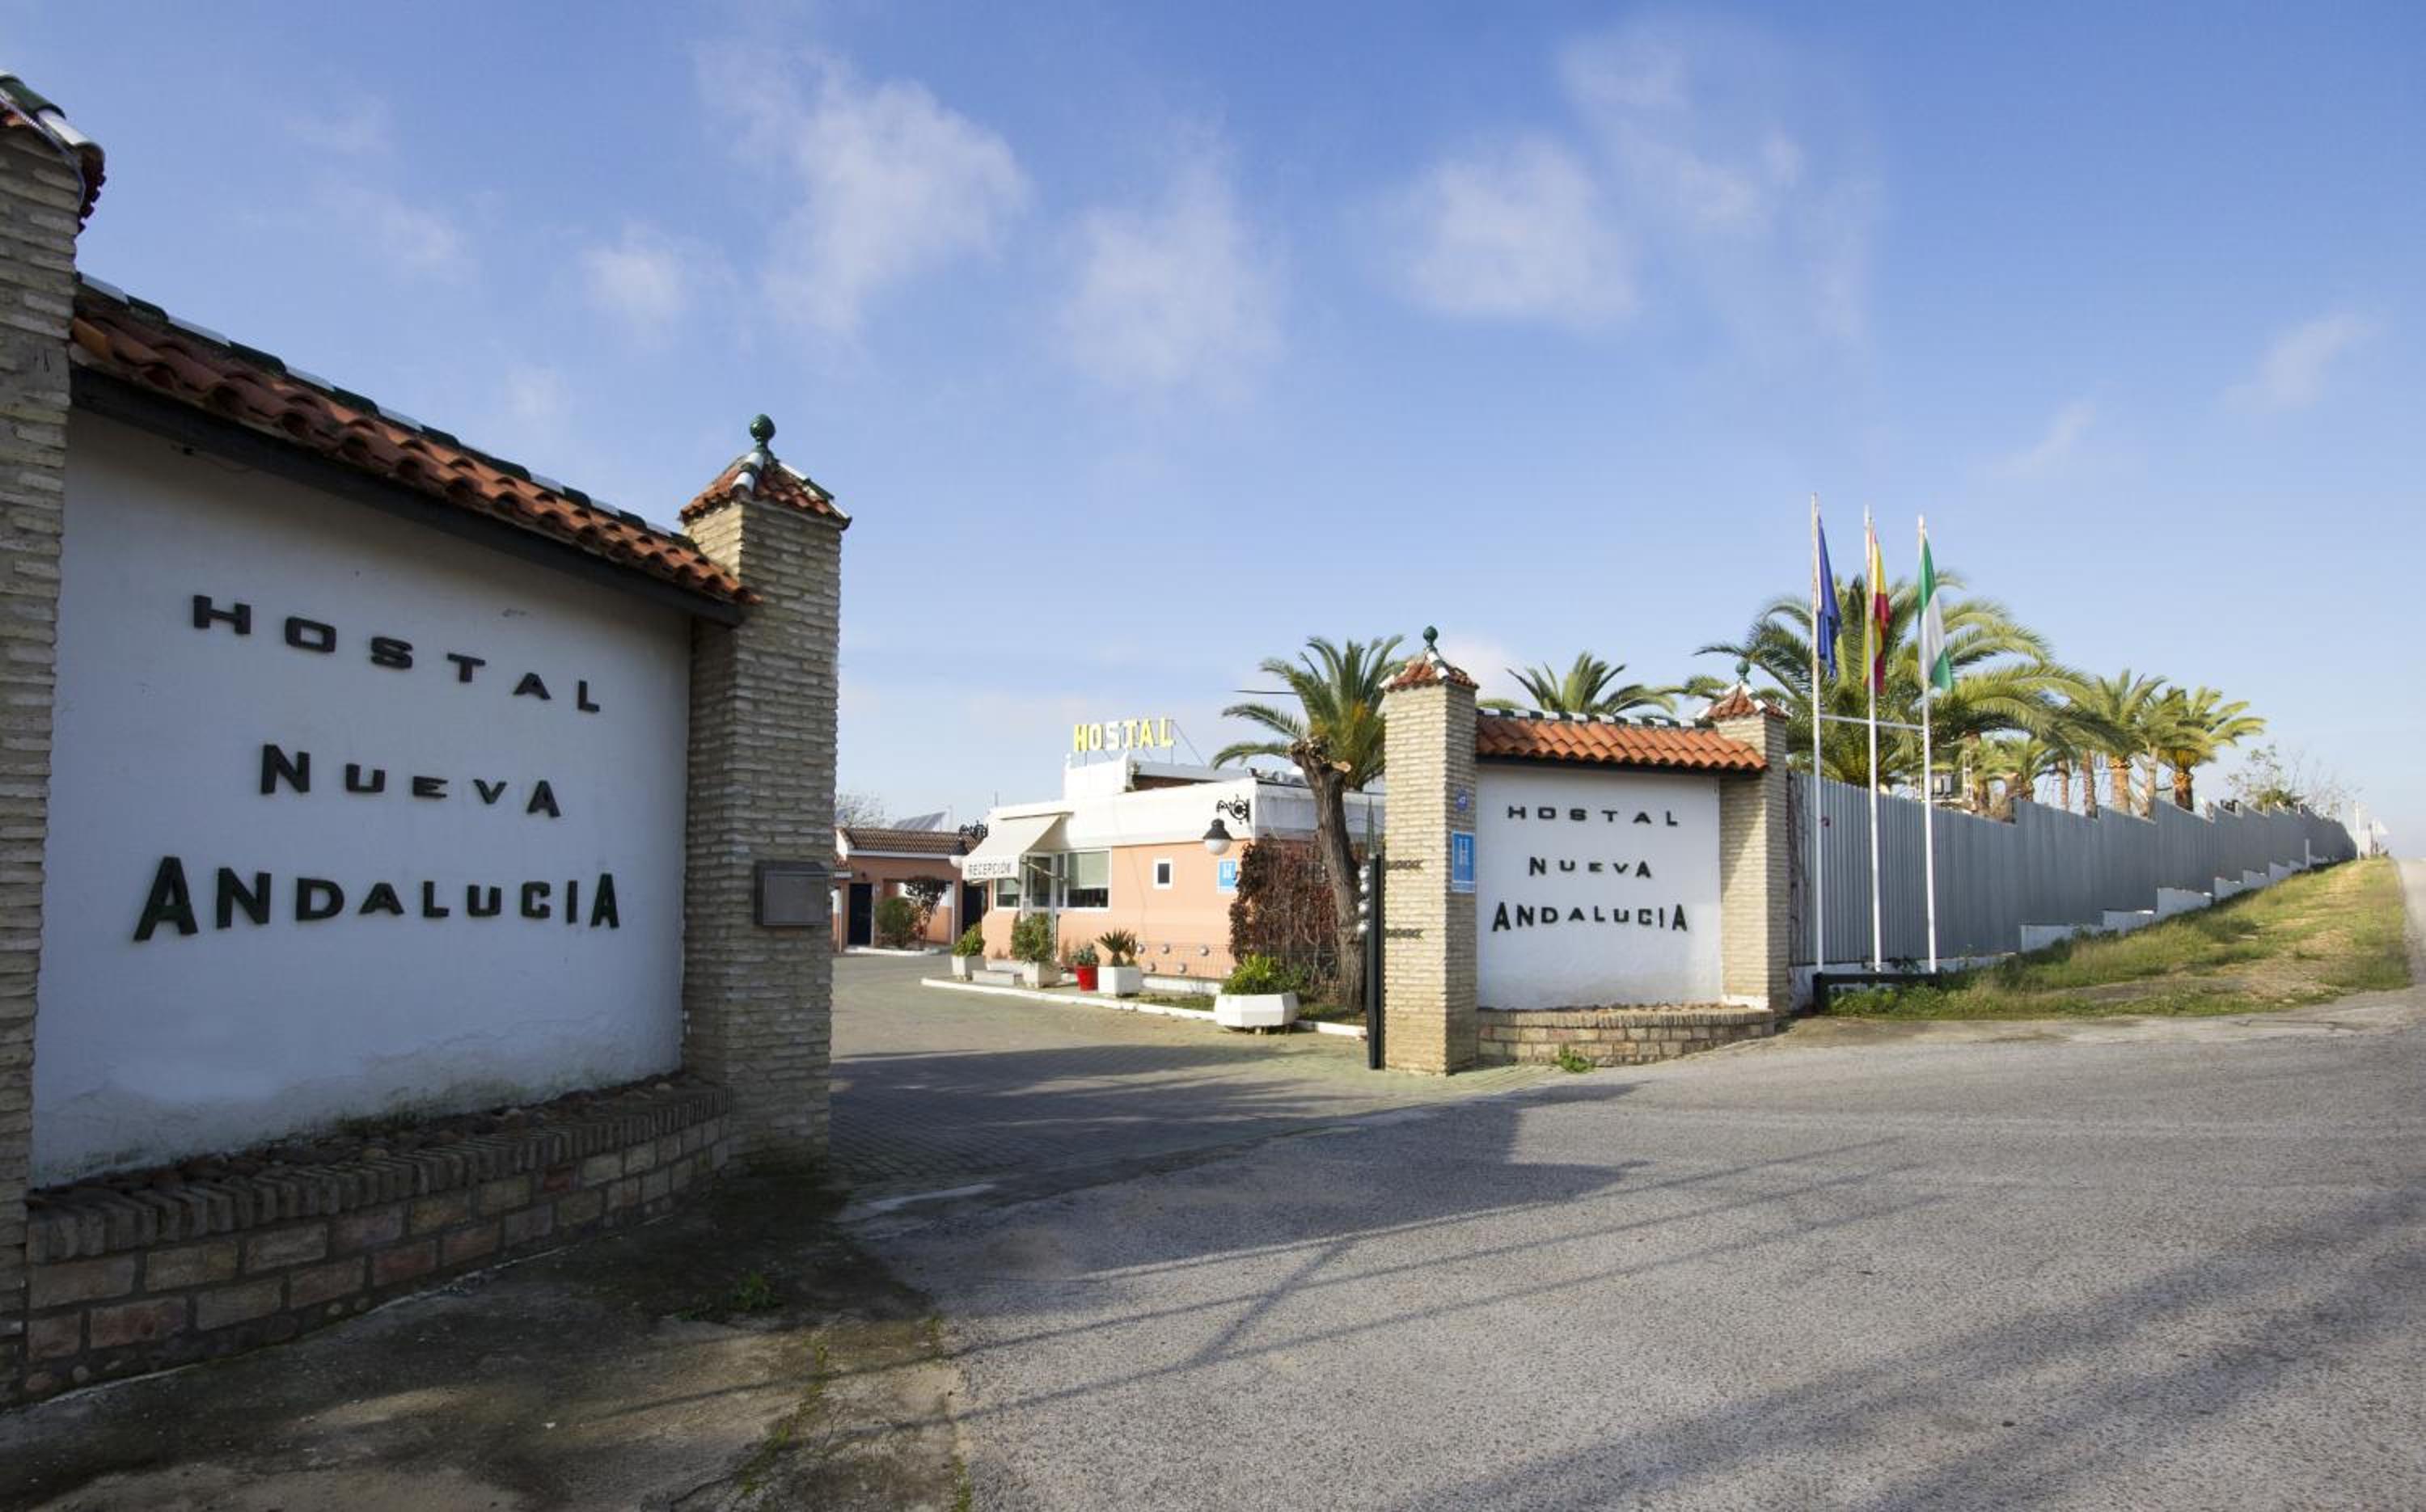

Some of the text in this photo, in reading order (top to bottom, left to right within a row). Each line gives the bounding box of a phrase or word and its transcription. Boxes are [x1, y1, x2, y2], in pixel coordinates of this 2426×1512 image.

[192, 594, 601, 714] HOSTAL
[1073, 717, 1177, 752] HOSTAL
[260, 743, 562, 818] NUEVA
[1507, 805, 1679, 827] HOSTAL
[1528, 855, 1652, 879] NUEVA
[132, 855, 621, 944] ANDALUCIA
[1491, 902, 1688, 932] ANDALUCIA
